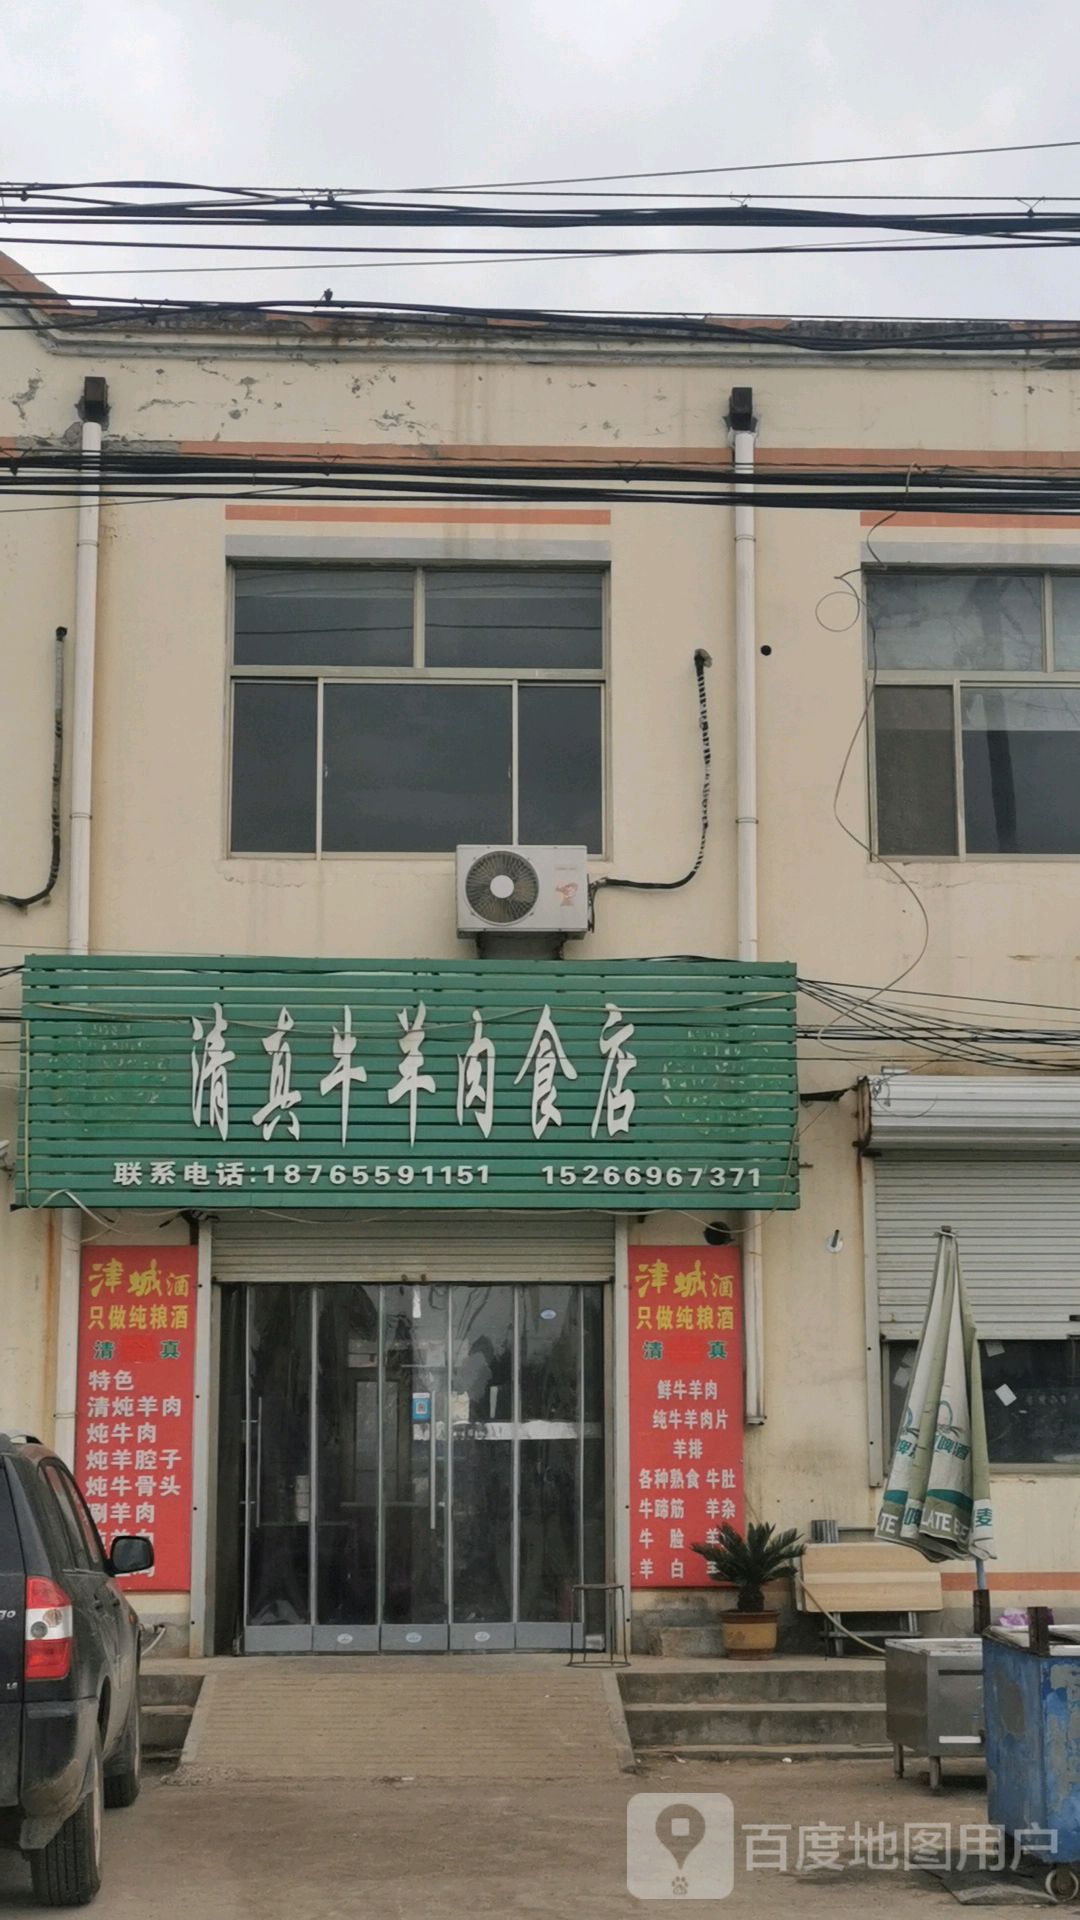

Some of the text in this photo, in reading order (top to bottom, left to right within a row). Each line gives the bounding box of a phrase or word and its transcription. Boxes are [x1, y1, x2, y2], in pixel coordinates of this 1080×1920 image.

[192, 1001, 637, 1148] 清真牛羊肉食店
[542, 1164, 760, 1187] 15266967371
[87, 1305, 188, 1330] 只做纯粮酒
[636, 1306, 734, 1330] 只做纯粮酒
[88, 1370, 134, 1391] 特色
[657, 1379, 717, 1401] 鲜牛羊肉
[87, 1396, 182, 1418] 清炖羊肉
[653, 1409, 728, 1430] 纯牛羊肉片
[86, 1422, 157, 1444] 炖牛肉
[86, 1449, 182, 1471] 炖羊腔子
[673, 1439, 703, 1460] 羊排
[85, 1475, 181, 1497] 炖牛骨头
[639, 1468, 736, 1489] 各种熟食 牛肚
[639, 1498, 735, 1519] 牛蹄筋 羊杂
